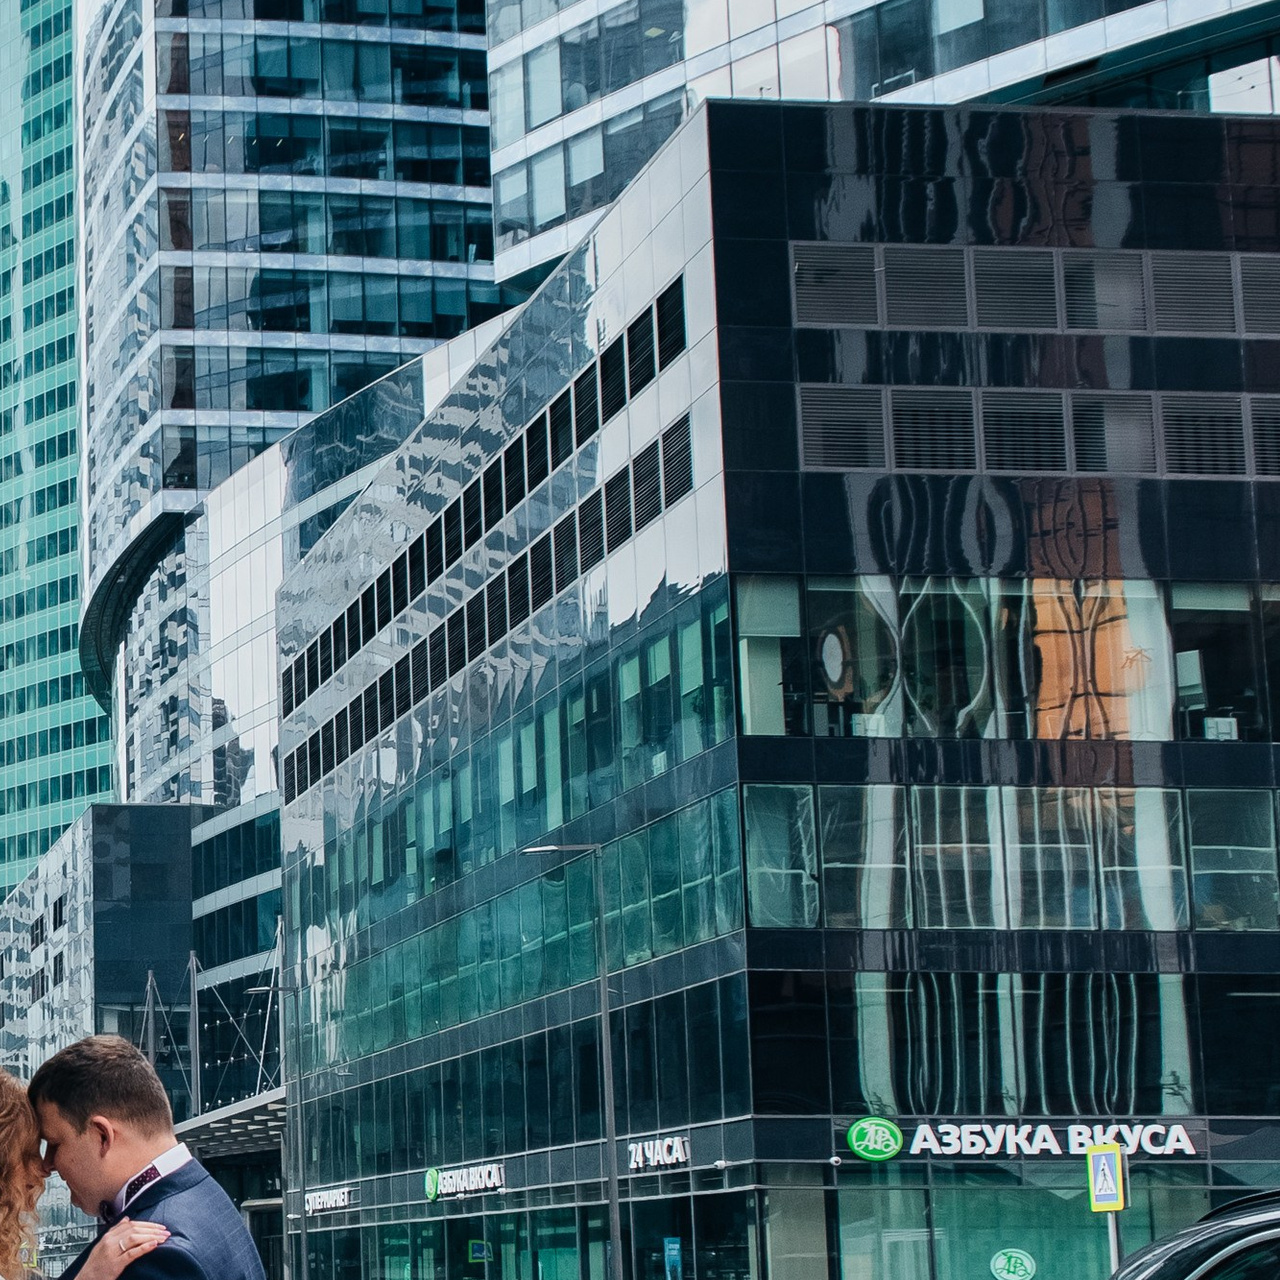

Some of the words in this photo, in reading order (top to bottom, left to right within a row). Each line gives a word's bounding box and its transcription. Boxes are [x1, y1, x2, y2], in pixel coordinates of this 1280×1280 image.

[628, 1142, 643, 1168] 24
[644, 1136, 687, 1166] ЧАСА
[910, 1124, 1062, 1155] АЗБУКА
[1067, 1124, 1196, 1155] ВКУСА
[438, 1169, 470, 1194] АЗБУКА
[469, 1163, 503, 1190] ВКУСА
[305, 1187, 351, 1214] СУПЕРМАРКЕТ
